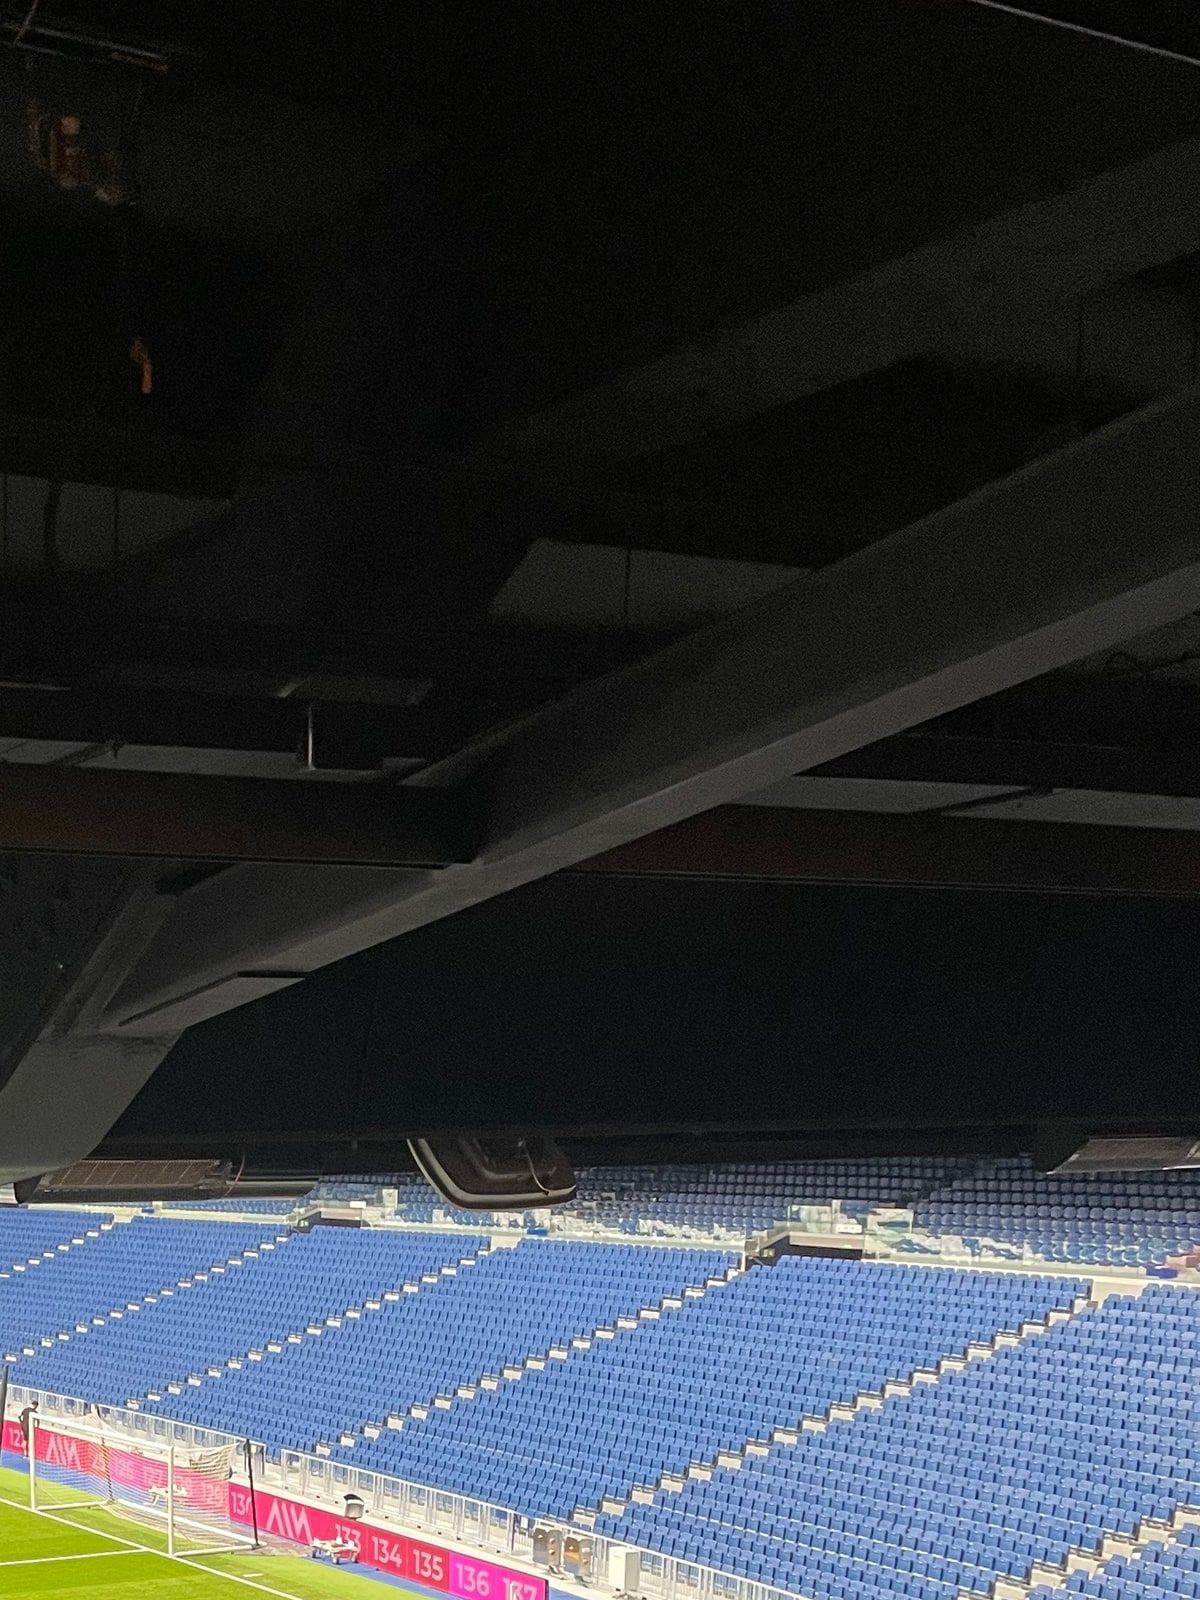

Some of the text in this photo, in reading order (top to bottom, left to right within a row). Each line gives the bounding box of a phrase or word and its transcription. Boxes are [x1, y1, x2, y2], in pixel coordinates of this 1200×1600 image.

[372, 1536, 403, 1568] 134
[413, 1549, 445, 1582] 135
[455, 1563, 490, 1597] 136
